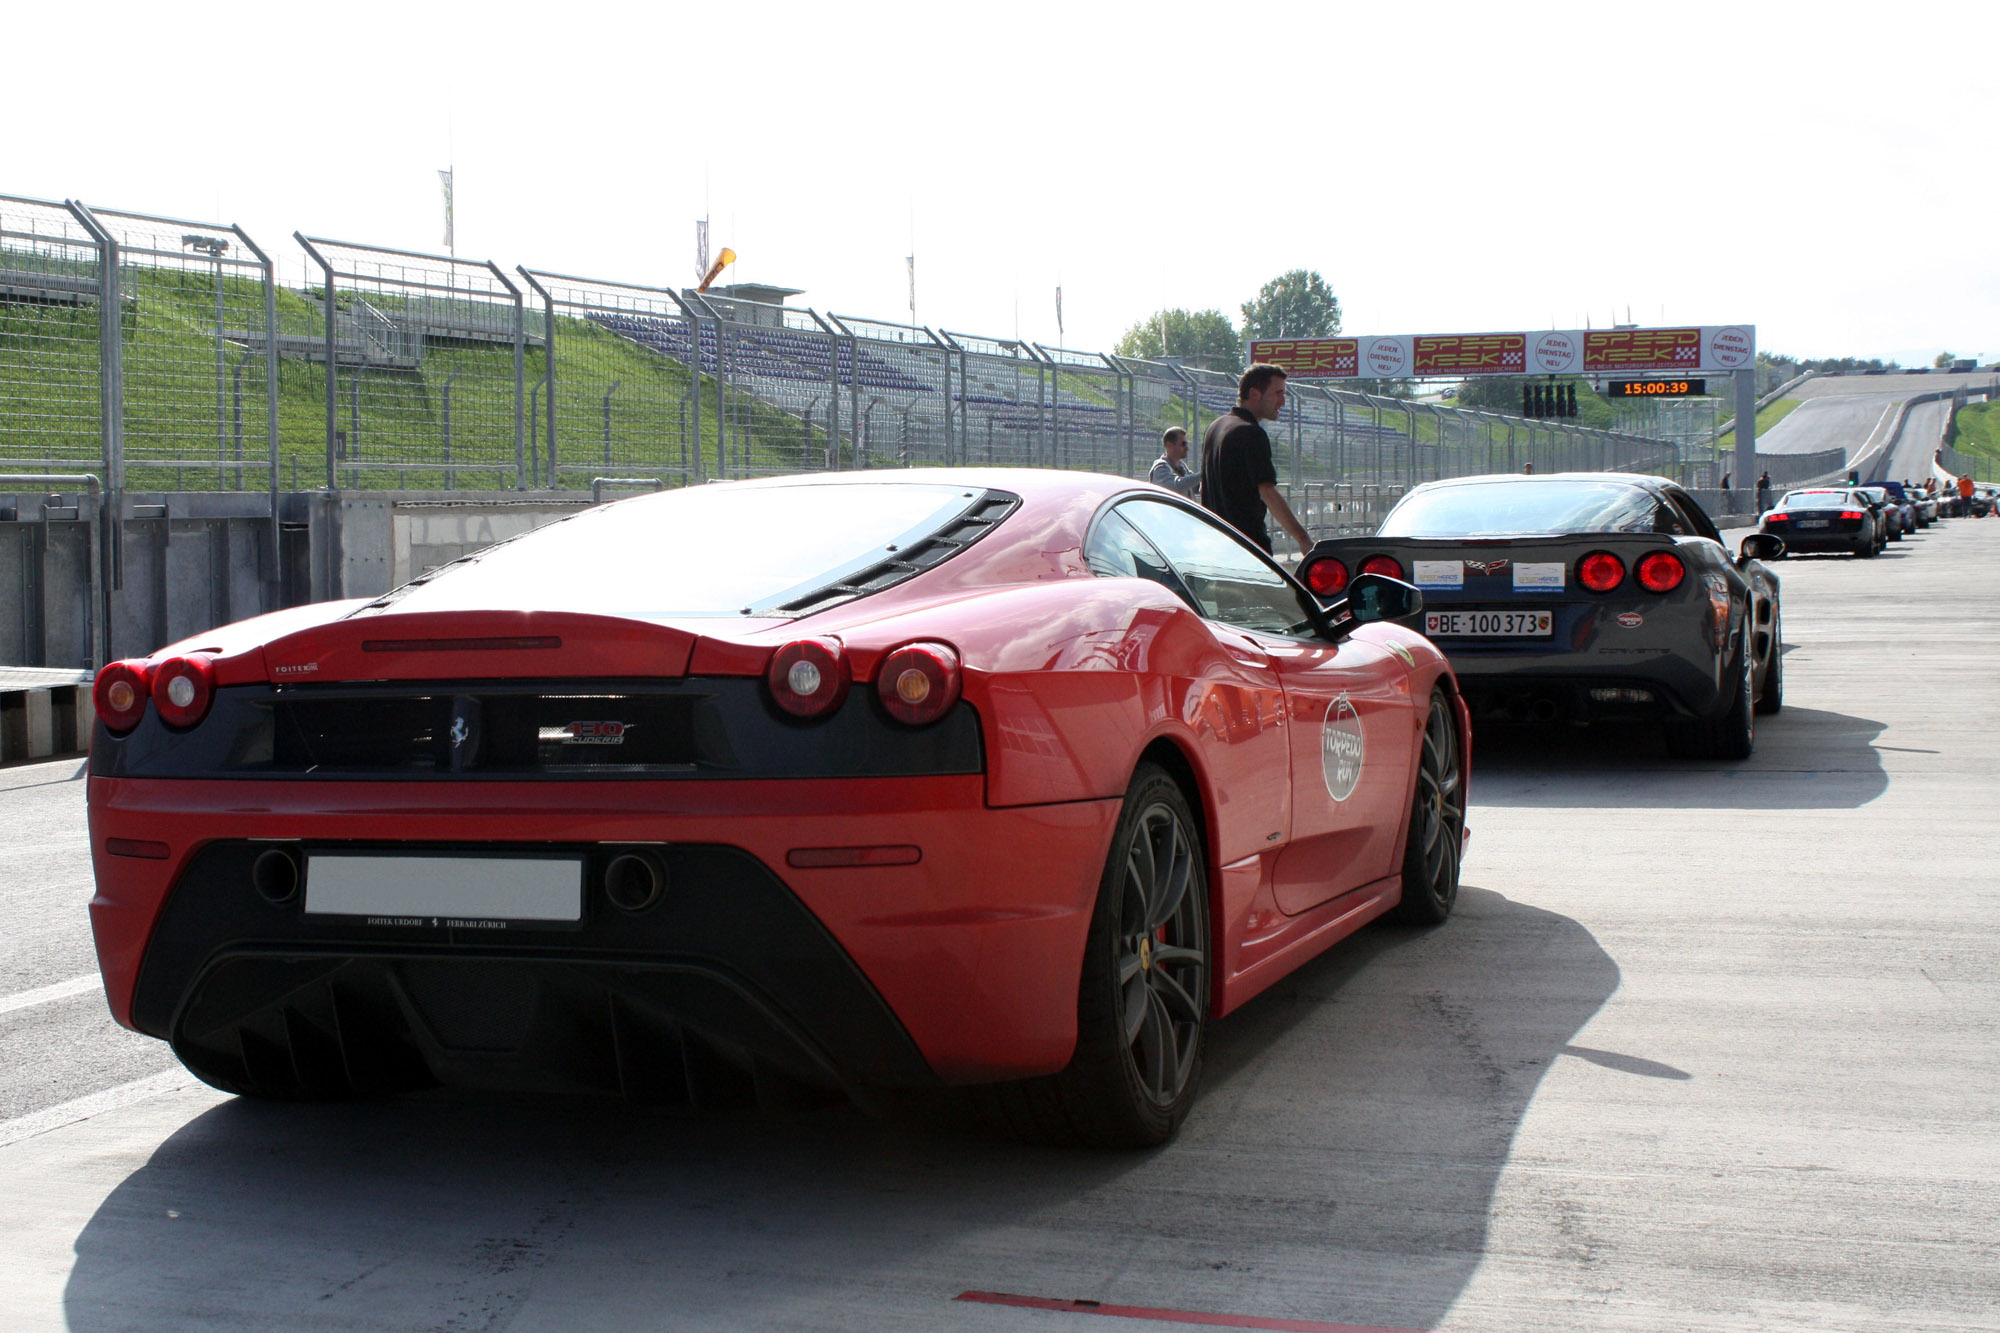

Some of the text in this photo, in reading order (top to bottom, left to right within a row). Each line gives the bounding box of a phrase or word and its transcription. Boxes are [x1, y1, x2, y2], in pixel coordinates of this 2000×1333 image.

[1418, 336, 1524, 351] SPEED
[1545, 340, 1567, 348] JEDEN
[1587, 331, 1699, 346] SPEED
[1721, 334, 1744, 343] JEDEN
[1254, 341, 1356, 355] SPEED
[1377, 344, 1398, 353] JEDEN
[1538, 348, 1571, 358] DIENSTAG
[1713, 343, 1748, 354] DIENSTAG
[1370, 354, 1401, 363] DIENSTAG
[1416, 352, 1499, 366] WEEK
[1586, 348, 1673, 362] WEEK
[1721, 355, 1737, 363] NEU
[1266, 358, 1333, 370] EEK
[1378, 363, 1391, 371] NEU
[1546, 359, 1560, 367] NEU
[1624, 382, 1689, 394] 15:00:39
[563, 721, 624, 737] 430
[561, 736, 624, 744] SCUDERIA
[1326, 727, 1361, 758] TORPEDO
[1337, 759, 1354, 783] RUN
[446, 919, 506, 928] FERRARI ZÜRICH
